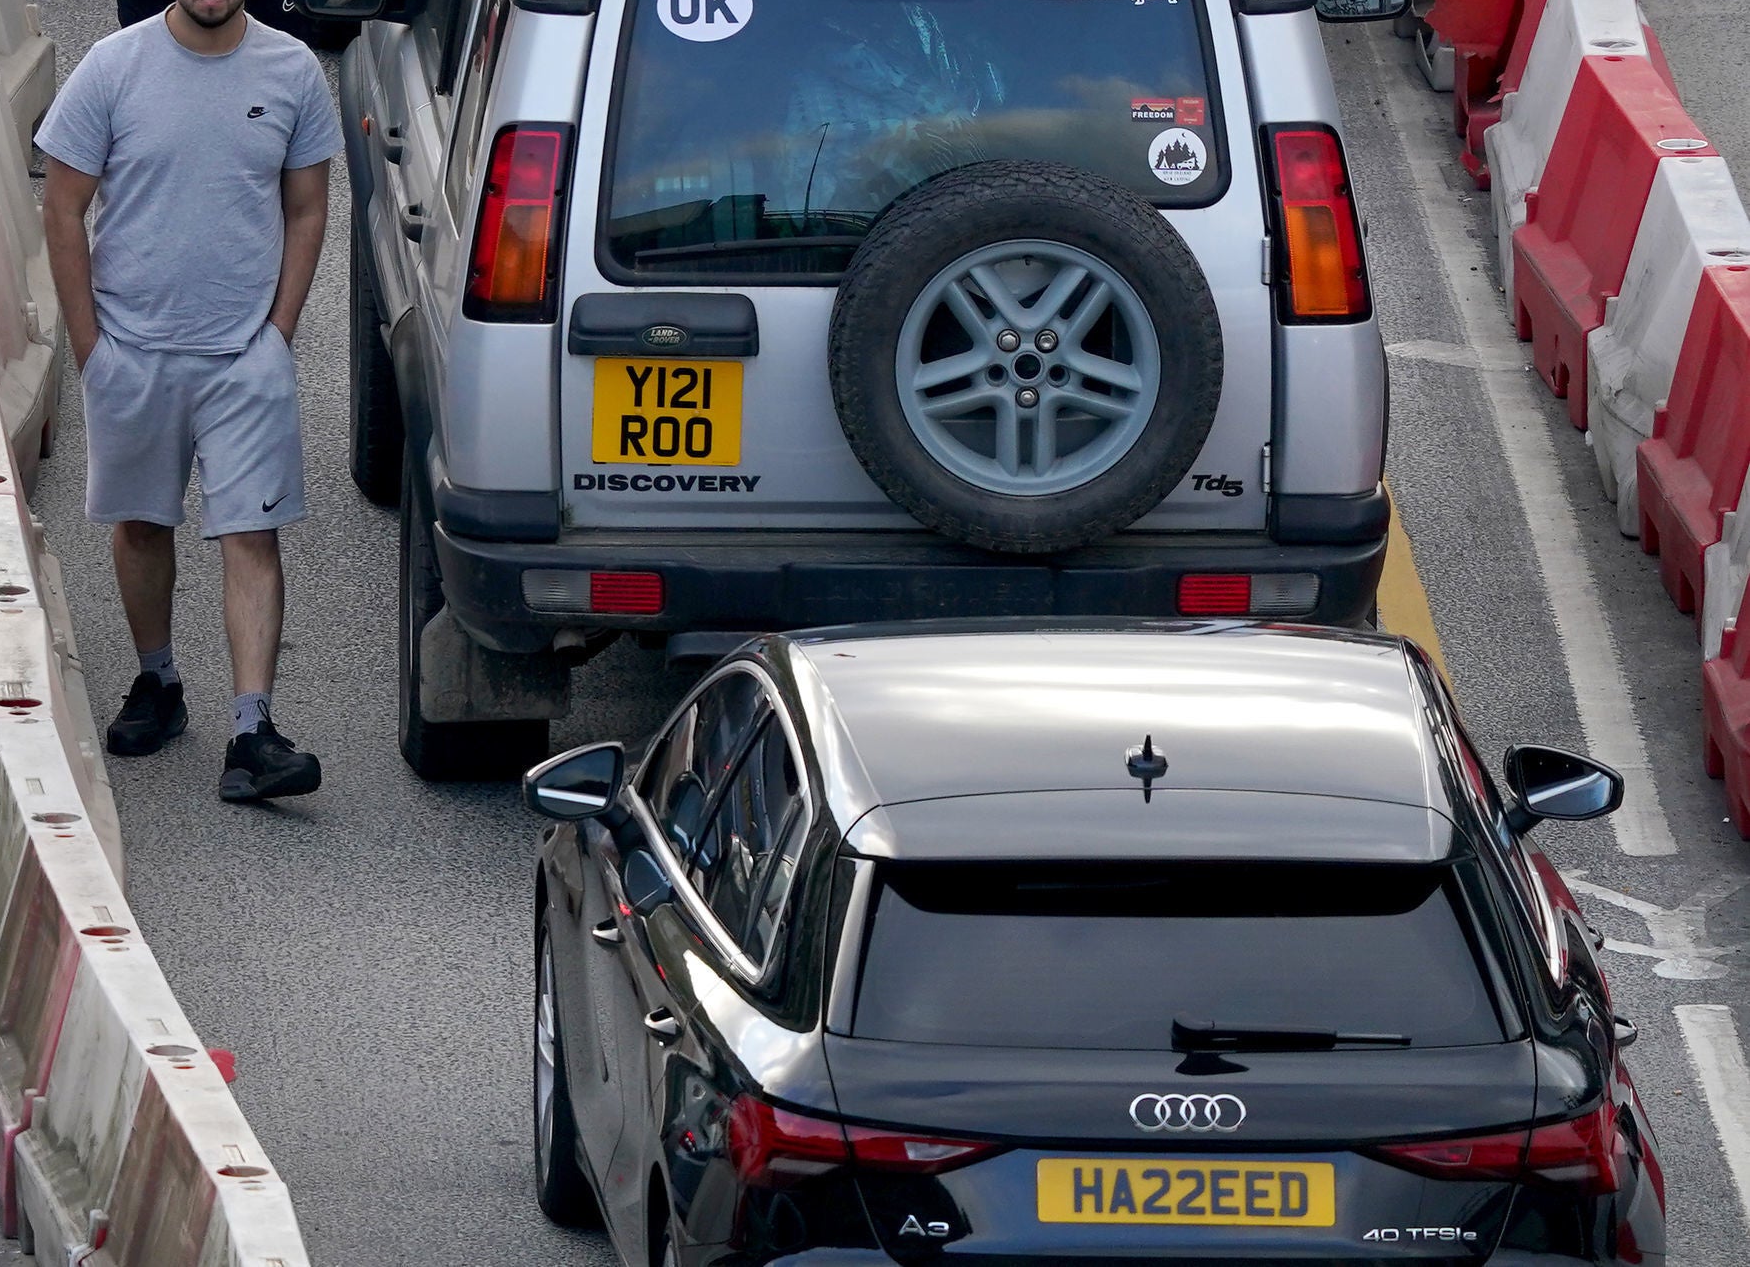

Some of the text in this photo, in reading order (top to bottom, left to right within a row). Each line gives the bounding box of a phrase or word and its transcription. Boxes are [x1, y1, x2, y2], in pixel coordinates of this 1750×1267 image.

[1132, 111, 1174, 119] FREEDOM
[651, 329, 673, 337] LAND
[626, 366, 712, 409] Y121
[573, 473, 762, 492] DISCOVERY
[1191, 474, 1244, 497] Td5
[1073, 1166, 1309, 1219] HA22EED
[898, 1214, 949, 1237] A3
[1362, 1228, 1400, 1242] 40
